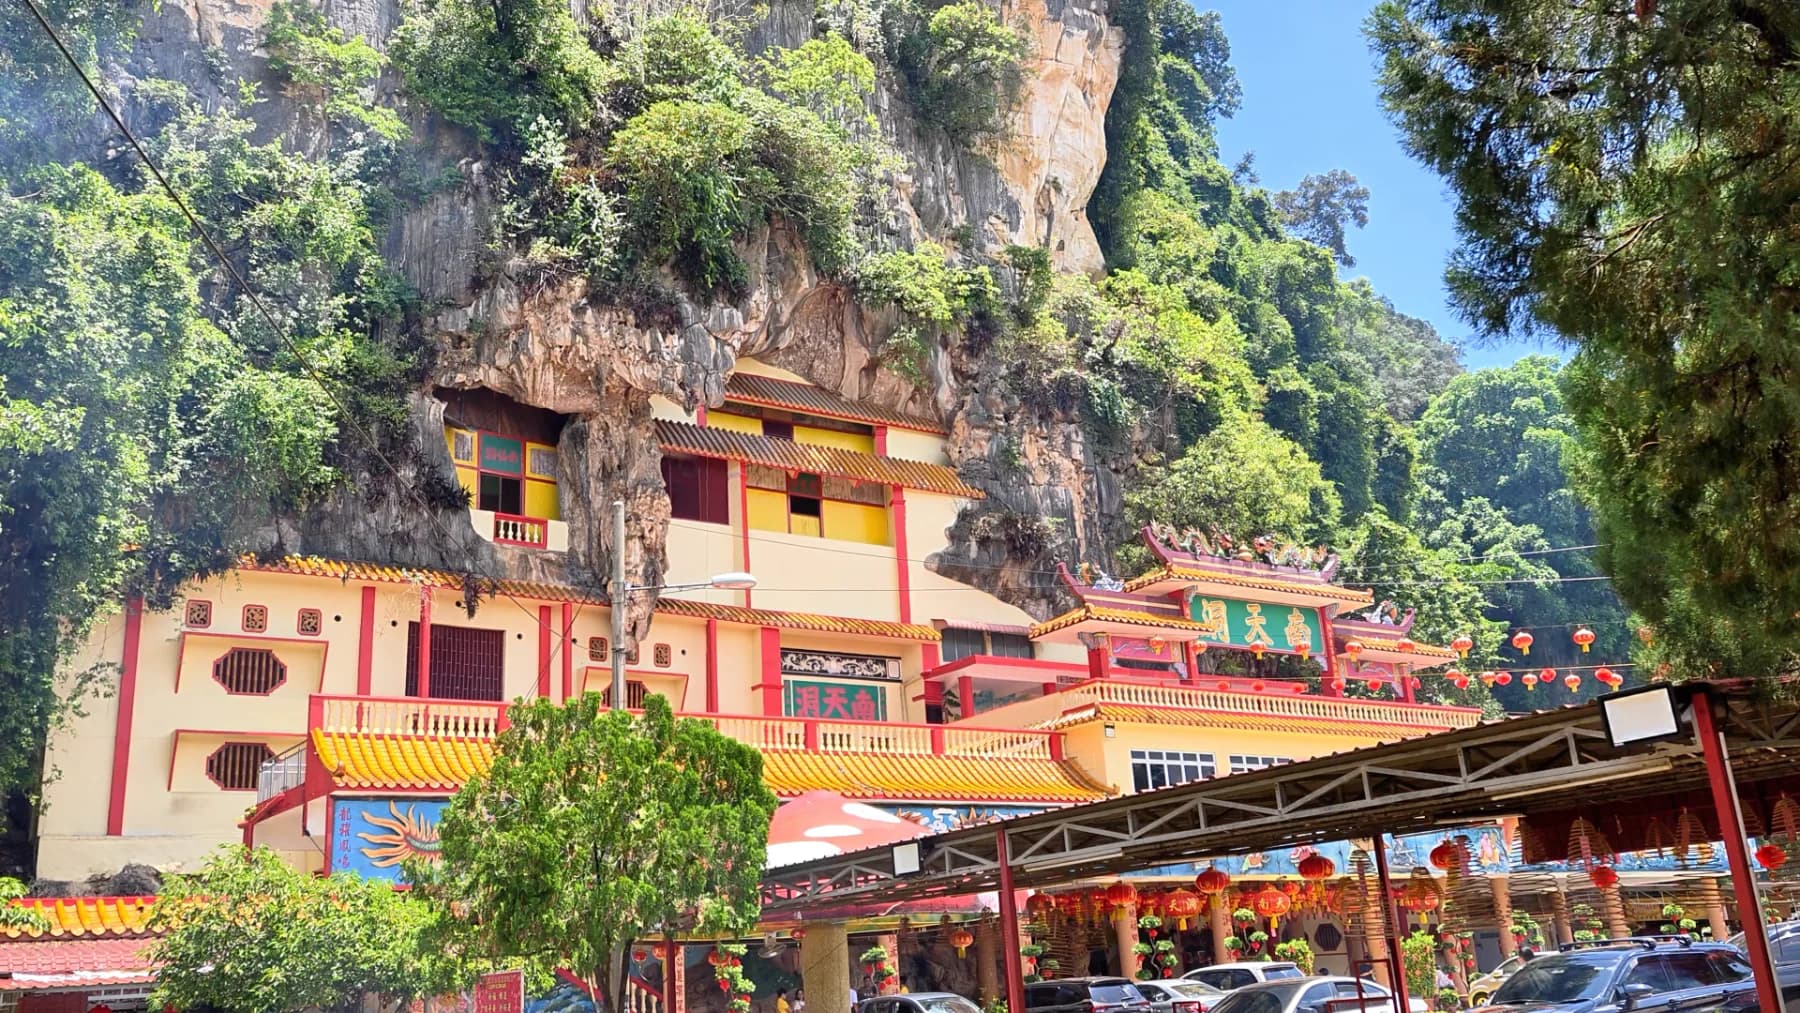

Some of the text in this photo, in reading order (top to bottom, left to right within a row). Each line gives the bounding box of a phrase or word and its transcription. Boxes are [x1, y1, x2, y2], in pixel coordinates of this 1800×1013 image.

[1202, 599, 1312, 647] 南天洞
[795, 686, 876, 722] 南天洞
